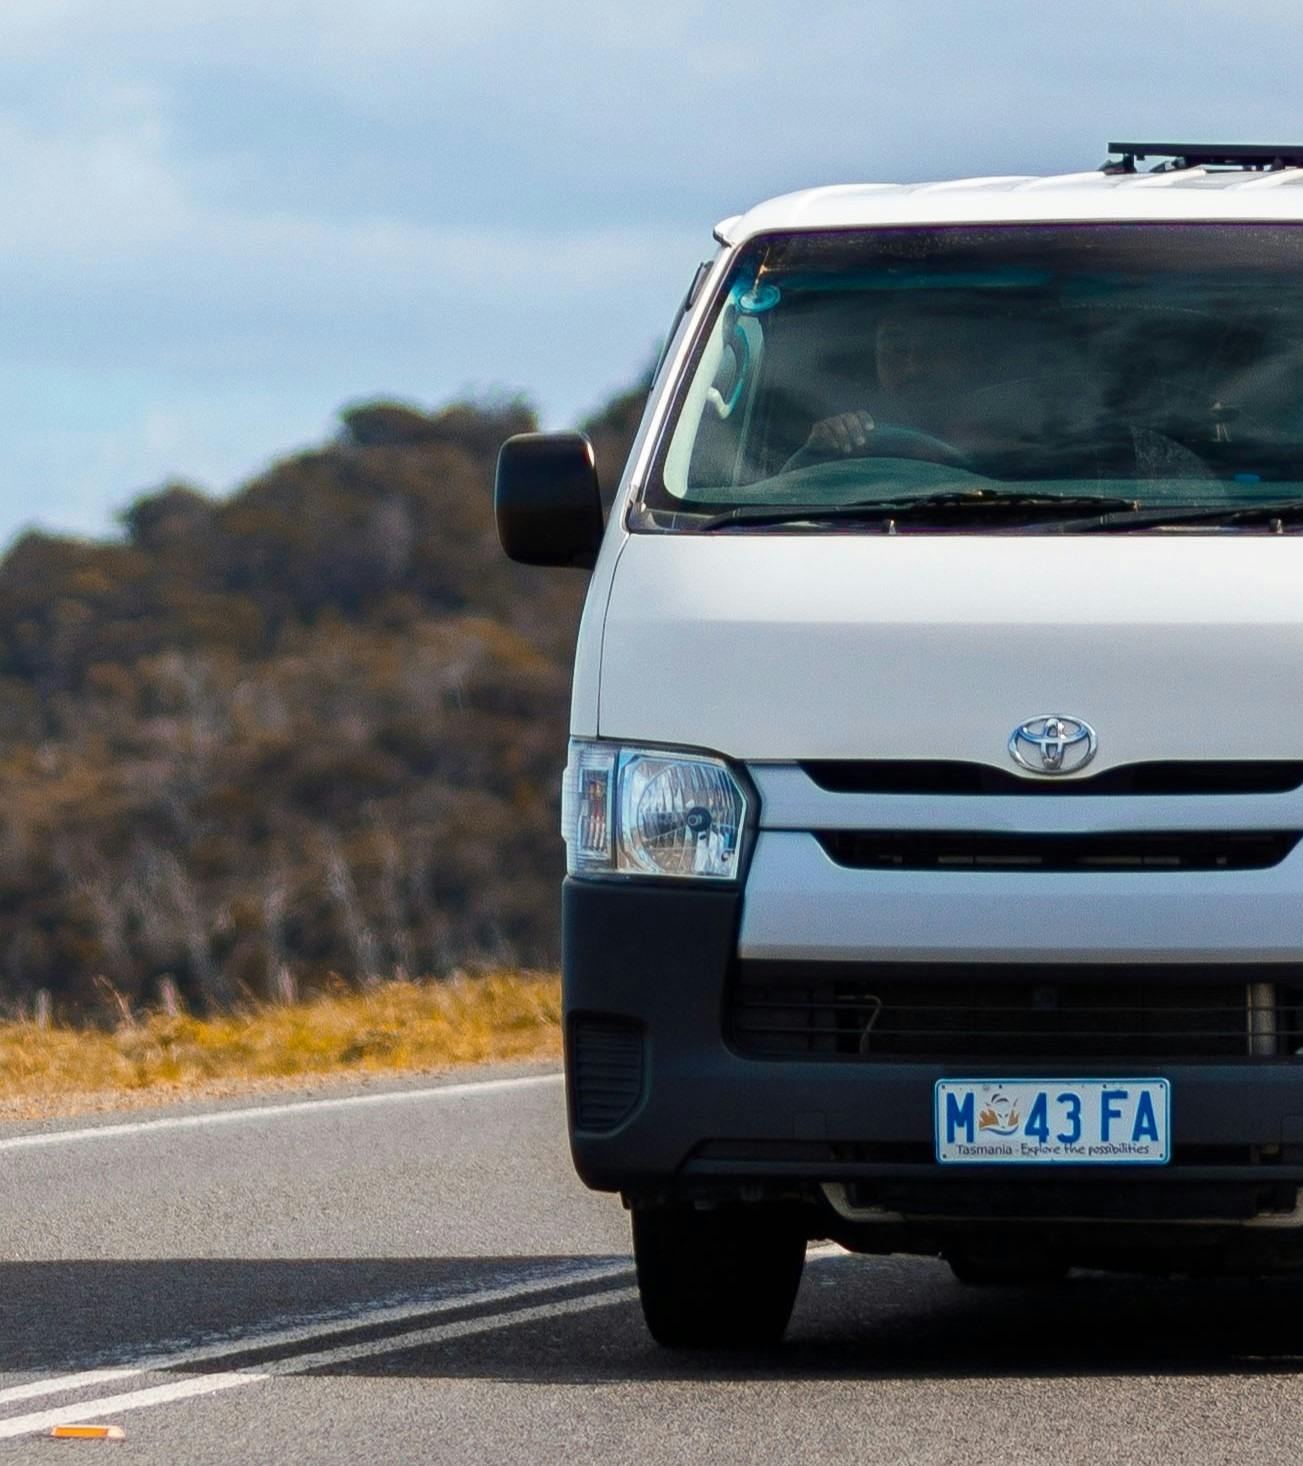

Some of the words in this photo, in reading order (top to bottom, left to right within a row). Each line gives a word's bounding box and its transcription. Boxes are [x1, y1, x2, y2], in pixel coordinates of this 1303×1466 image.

[946, 1092, 975, 1143] M
[1024, 1092, 1082, 1143] 43
[1101, 1090, 1159, 1142] FA
[957, 1144, 1013, 1155] Tasmania
[1020, 1143, 1061, 1156] Explore
[1064, 1143, 1085, 1154] the
[1088, 1142, 1150, 1155] possibilities
